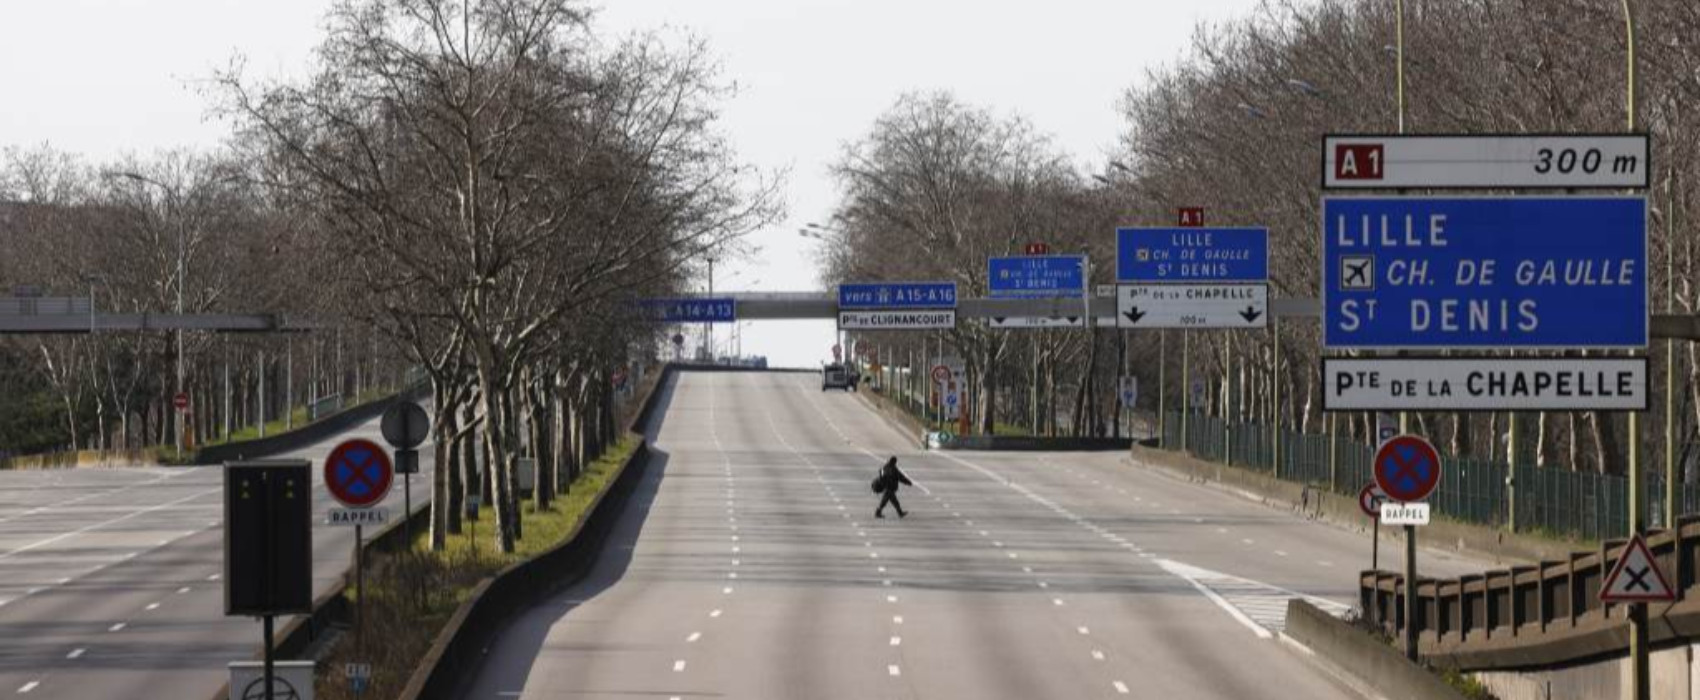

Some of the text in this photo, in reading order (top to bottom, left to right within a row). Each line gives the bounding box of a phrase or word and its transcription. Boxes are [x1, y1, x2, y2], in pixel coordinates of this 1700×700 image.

[1534, 149, 1637, 174] 300 m
[1338, 214, 1448, 246] LILLE
[1172, 233, 1213, 247] LILLE
[1180, 249, 1197, 261] DE
[1181, 263, 1229, 277] DENIS
[1387, 260, 1635, 286] CH. DE GAULLE
[1186, 288, 1254, 300] CHAPELLE
[871, 314, 952, 325] CLIGNANCOURT
[1411, 299, 1540, 332] DENIS
[1391, 380, 1417, 397] DE
[1428, 380, 1452, 397] LA
[1466, 372, 1634, 397] CHAPELLE
[332, 511, 384, 522] RAPPEL
[1386, 508, 1424, 519] RAPPEL
